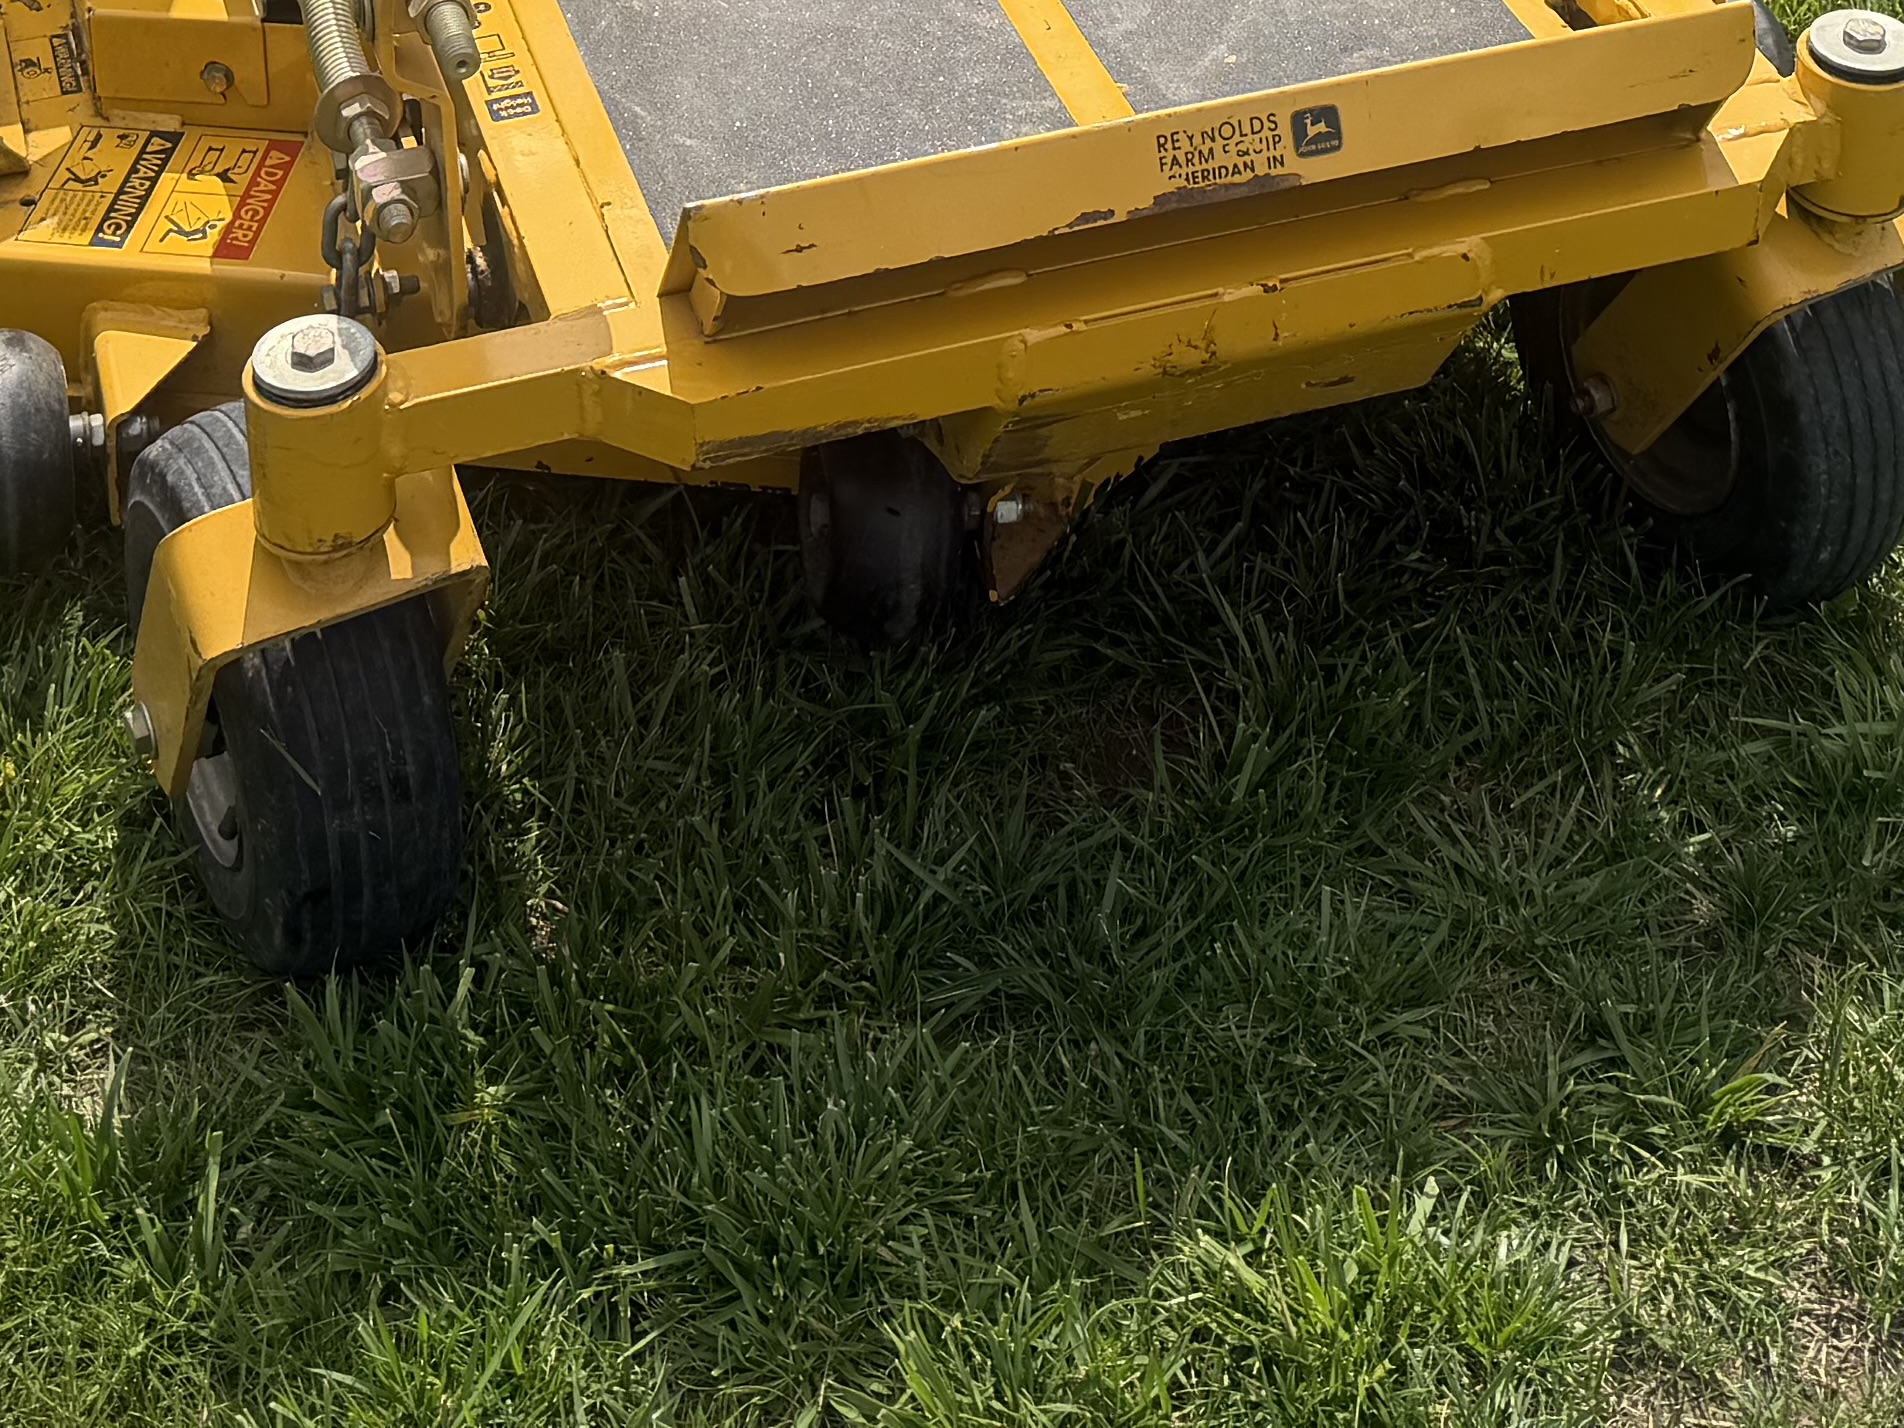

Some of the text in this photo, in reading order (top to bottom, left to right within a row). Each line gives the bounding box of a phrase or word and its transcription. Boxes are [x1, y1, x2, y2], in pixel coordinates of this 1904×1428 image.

[1156, 112, 1279, 154] REYNOLDS
[1159, 146, 1215, 173] FARM
[1267, 154, 1285, 170] IN
[98, 150, 168, 242] WARNING!
[226, 165, 285, 248] DANGER!
